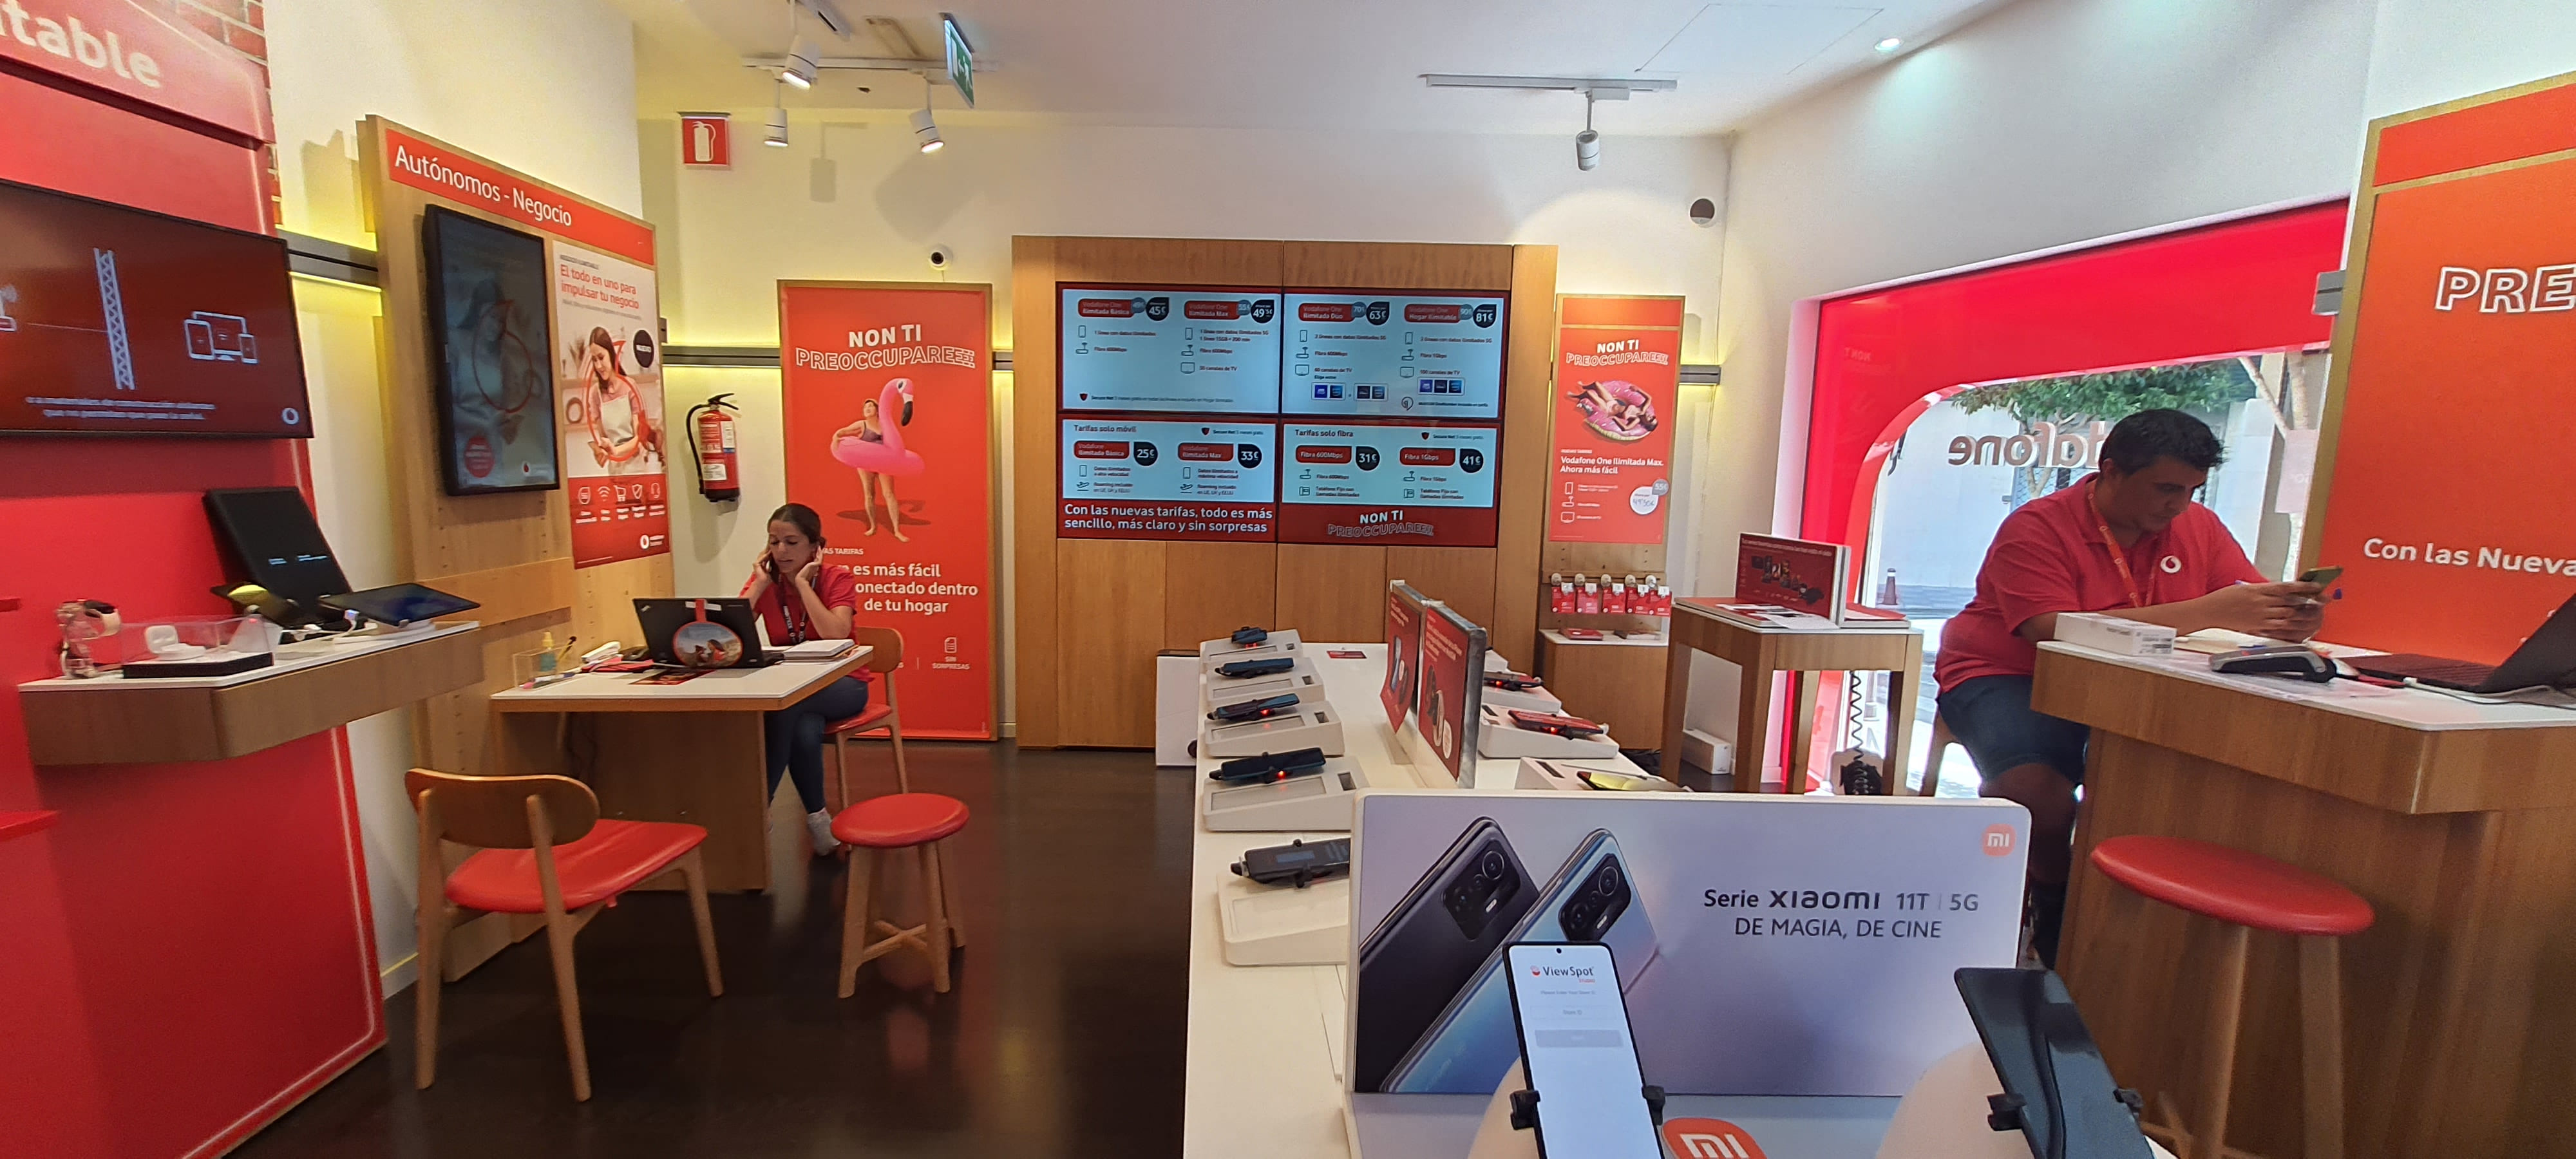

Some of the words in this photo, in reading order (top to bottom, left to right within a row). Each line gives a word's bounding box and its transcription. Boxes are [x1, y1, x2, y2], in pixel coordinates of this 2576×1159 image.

[0, 0, 160, 88] table
[395, 146, 500, 202] Autónomos
[513, 188, 572, 226] Negocio
[561, 264, 569, 277] El
[571, 270, 591, 283] todo
[592, 276, 602, 286] en
[604, 279, 619, 290] uno
[620, 283, 636, 294] para
[561, 280, 599, 299] impulsar
[600, 291, 609, 301] tu
[611, 294, 639, 309] negocio
[2435, 263, 2576, 314] PRE
[1149, 306, 1166, 316] 45€
[1369, 310, 1386, 319] 63€
[1475, 313, 1493, 322] 81€
[849, 326, 895, 348] NON
[901, 324, 921, 342] TI
[1597, 341, 1625, 353] NON
[1627, 339, 1639, 350] TI
[1137, 449, 1155, 458] 25€
[1241, 451, 1259, 460] 33€
[1359, 453, 1377, 462] 31€
[1463, 456, 1481, 465] 41€
[1561, 457, 1595, 465] Vodafone
[1613, 457, 1645, 466] Ilimitada
[1584, 466, 1601, 474] más
[1065, 504, 1088, 515] Con
[1091, 505, 1109, 515] las
[1111, 507, 1154, 516] nuevas
[1157, 506, 1198, 518] tarifas,
[1200, 507, 1227, 518] todo
[1231, 509, 1244, 518] es
[1247, 507, 1273, 519] más
[1359, 512, 1388, 524] NON
[1391, 510, 1403, 521] TI
[1065, 518, 1115, 530] sencillo,
[1117, 519, 1143, 530] más
[1146, 520, 1176, 531] claro
[1178, 522, 1186, 532] y
[1188, 521, 1206, 531] sin
[1208, 523, 1267, 534] sorpresas
[2363, 538, 2416, 561] Con
[2425, 542, 2469, 566] las
[2477, 547, 2576, 577] Nueva
[853, 565, 871, 576] es
[874, 562, 905, 576] más
[907, 563, 941, 577] fácil
[855, 581, 925, 594] onectado
[928, 582, 978, 596] dentro
[864, 598, 882, 611] de
[885, 599, 901, 611] tu
[905, 599, 949, 616] hogar
[1703, 889, 1759, 908] Serie
[1897, 892, 1930, 910] 11T
[1949, 894, 1979, 911] 5G
[1735, 918, 1763, 936] DE
[1771, 918, 1848, 940] MAGIA,
[1857, 920, 1885, 937] DE
[1891, 920, 1942, 939] CINE
